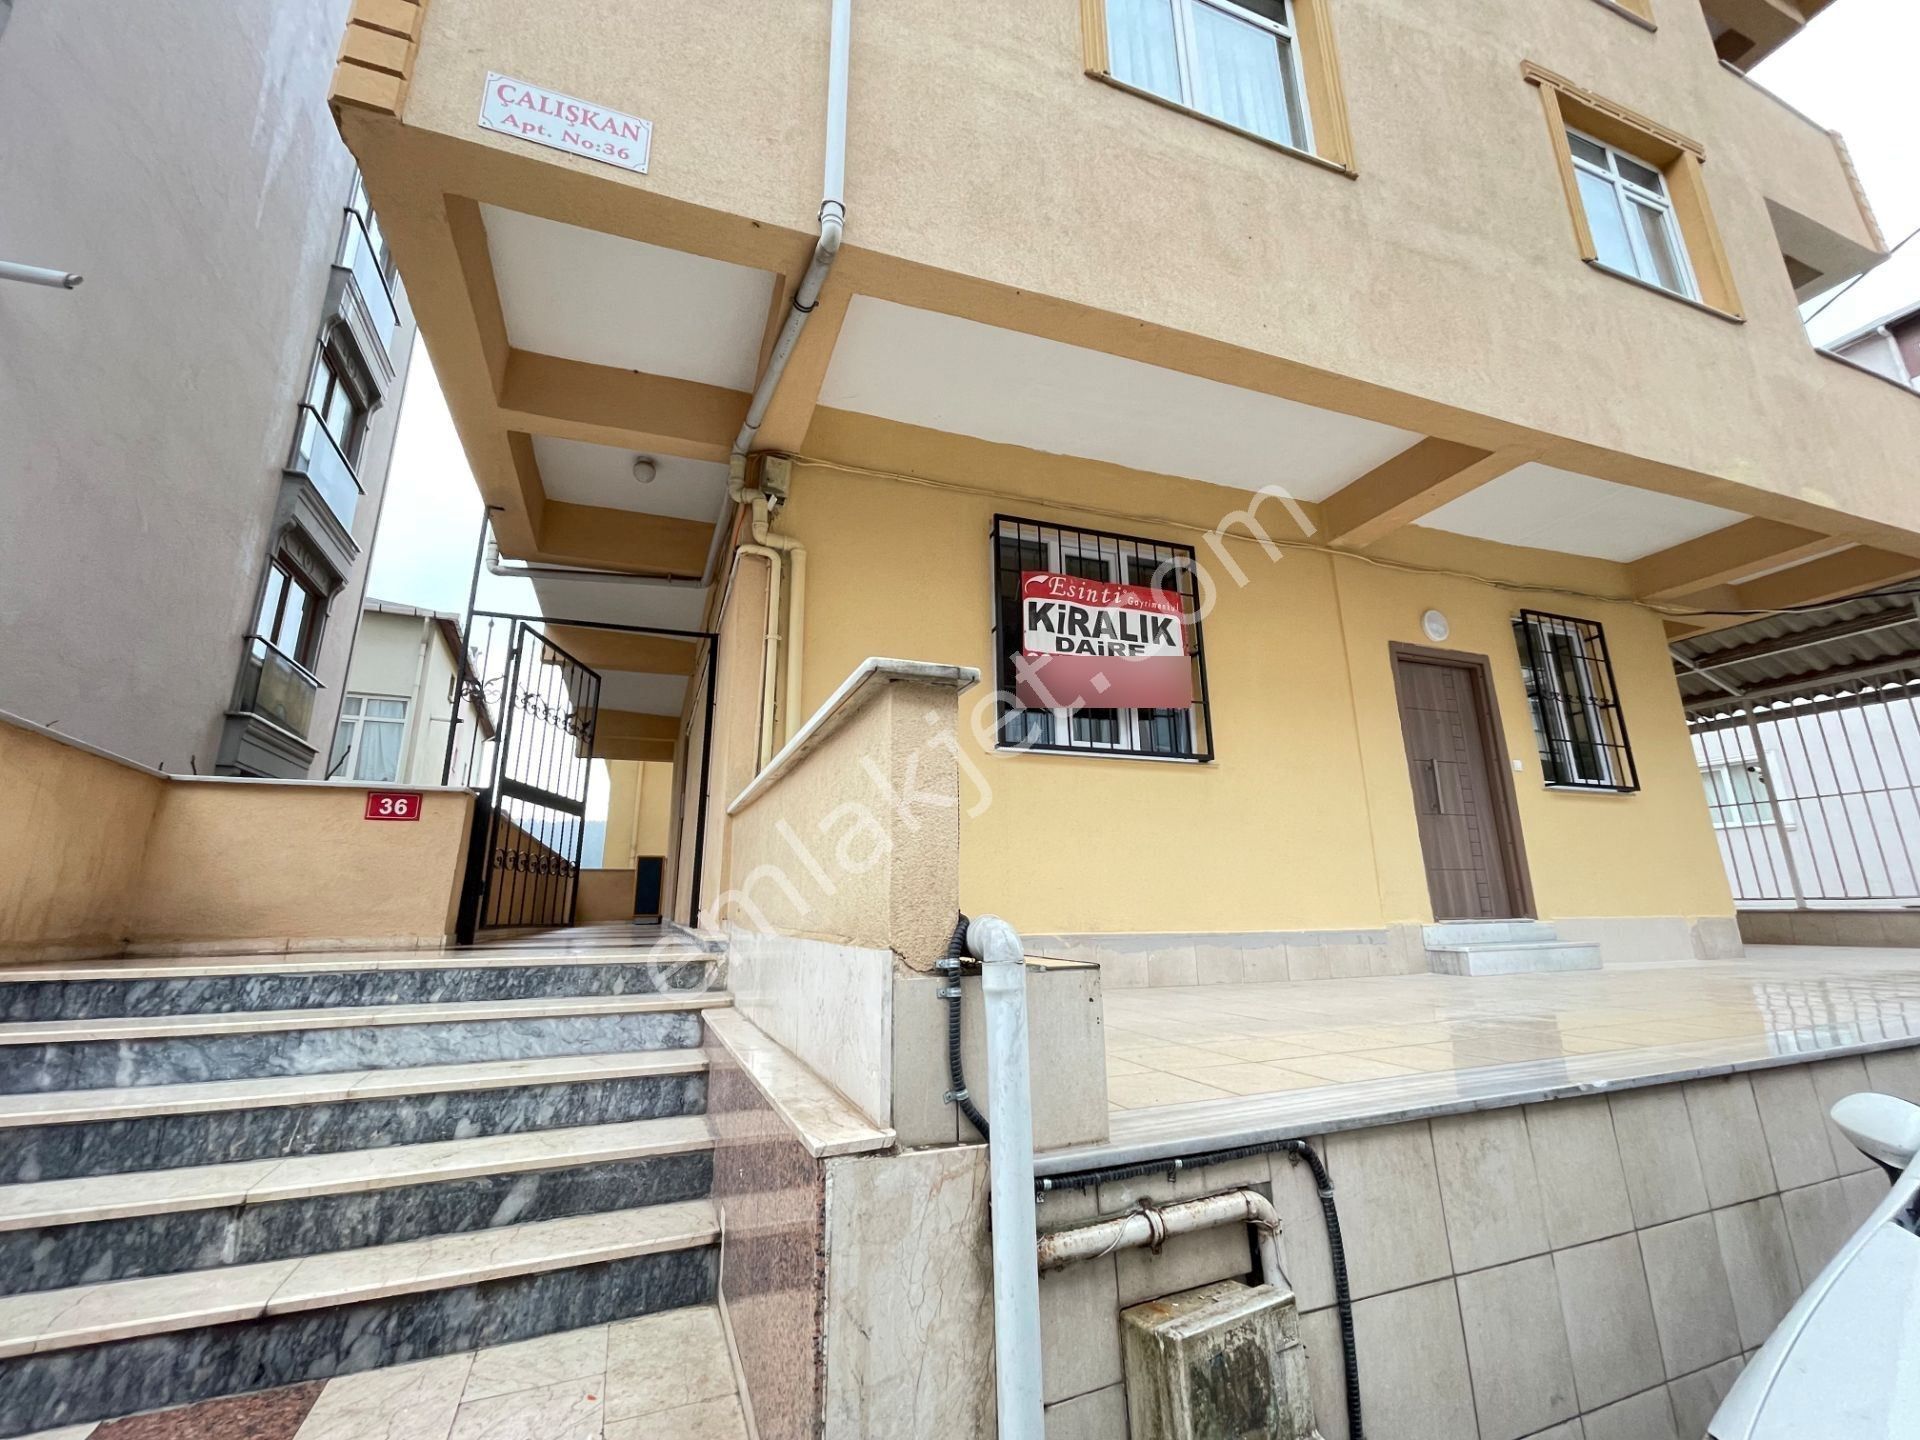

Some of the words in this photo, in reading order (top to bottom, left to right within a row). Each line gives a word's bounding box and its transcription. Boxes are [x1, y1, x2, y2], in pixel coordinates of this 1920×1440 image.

[497, 84, 641, 142] ÇALIŞKAN
[501, 114, 552, 138] Apt.
[561, 130, 630, 160] No:36
[1048, 576, 1122, 604] Esinti
[379, 798, 408, 815] 36
